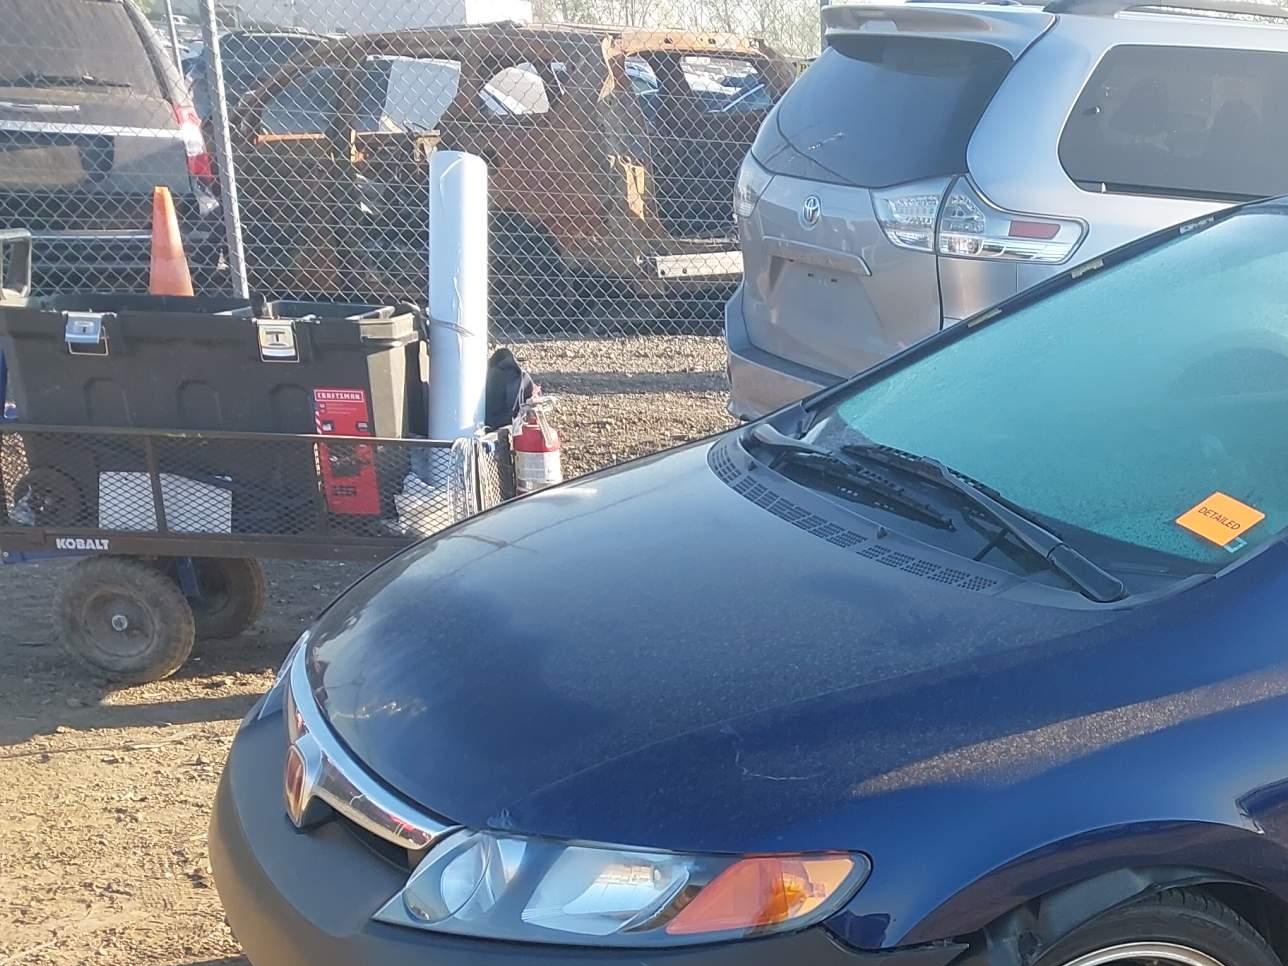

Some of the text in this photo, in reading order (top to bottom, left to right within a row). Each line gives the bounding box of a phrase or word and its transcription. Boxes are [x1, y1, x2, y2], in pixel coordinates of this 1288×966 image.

[317, 391, 361, 401] CRAFTSMAN
[1197, 506, 1241, 531] DETAILED
[55, 537, 109, 550] KOBALT
